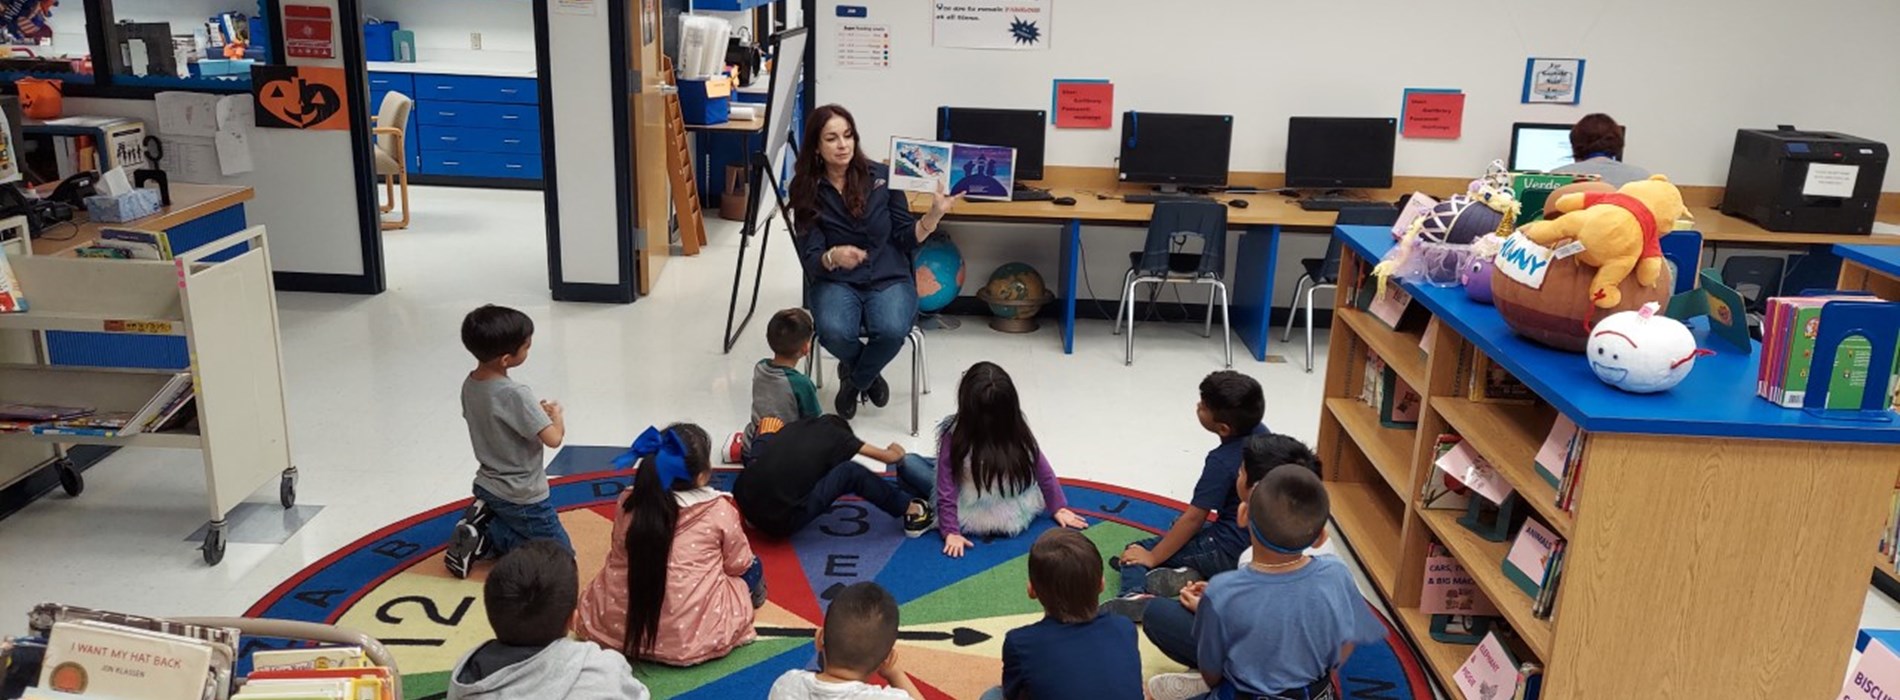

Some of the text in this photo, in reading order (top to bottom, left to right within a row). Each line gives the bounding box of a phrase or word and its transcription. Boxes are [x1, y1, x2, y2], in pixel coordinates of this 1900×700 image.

[1523, 177, 1562, 189] Verde
[592, 481, 626, 497] D
[1099, 498, 1130, 515] J
[819, 503, 871, 537] 3
[1526, 526, 1553, 550] ANIMALS
[372, 539, 422, 559] B
[824, 554, 860, 577] E
[1429, 564, 1452, 573] CARS,
[1436, 577, 1451, 585] BIG
[294, 588, 347, 608] A
[78, 643, 108, 656] WANT
[111, 649, 128, 660] MY
[130, 652, 151, 664] HAT
[153, 656, 183, 669] BACK
[101, 665, 146, 678] JON KLASSEN
